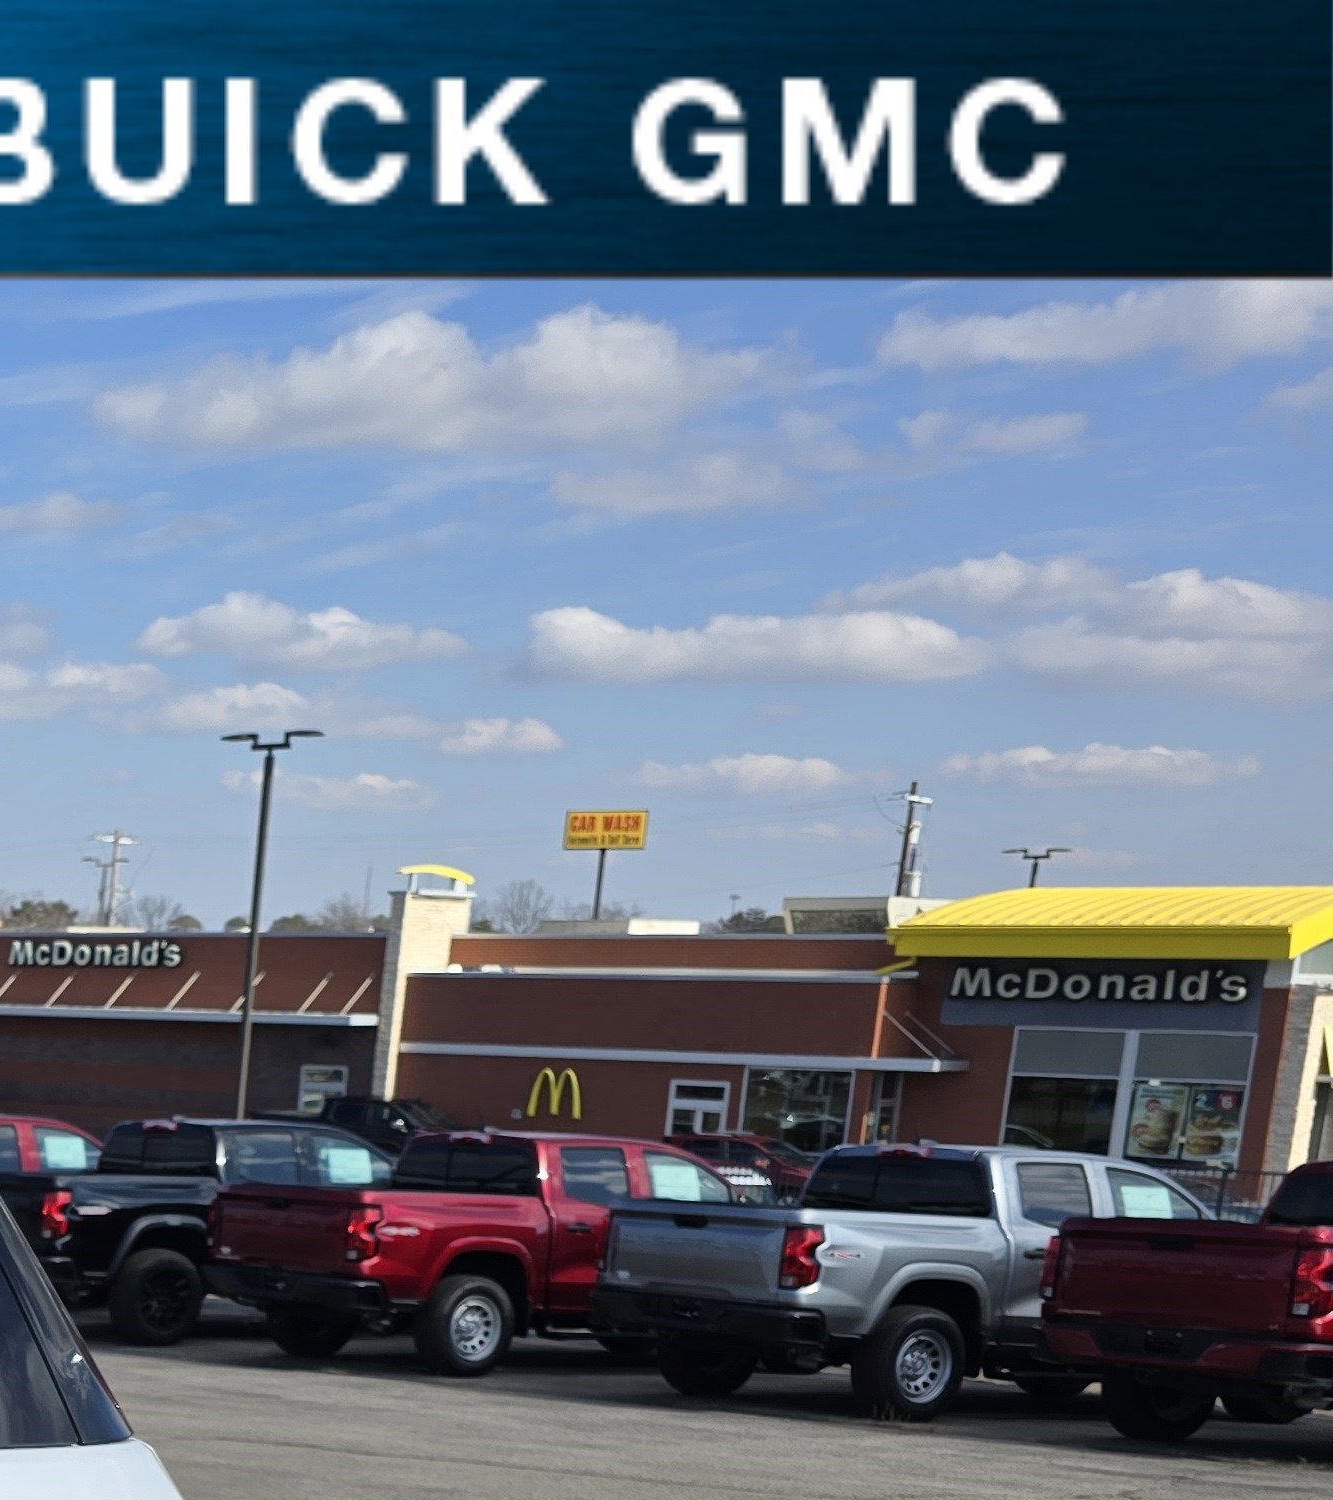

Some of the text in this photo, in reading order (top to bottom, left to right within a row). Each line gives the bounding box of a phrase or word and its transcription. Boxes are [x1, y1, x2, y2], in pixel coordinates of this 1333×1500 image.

[570, 815, 642, 832] CAR WASH
[8, 939, 182, 968] McDonald's
[950, 967, 1248, 1002] McDonald's
